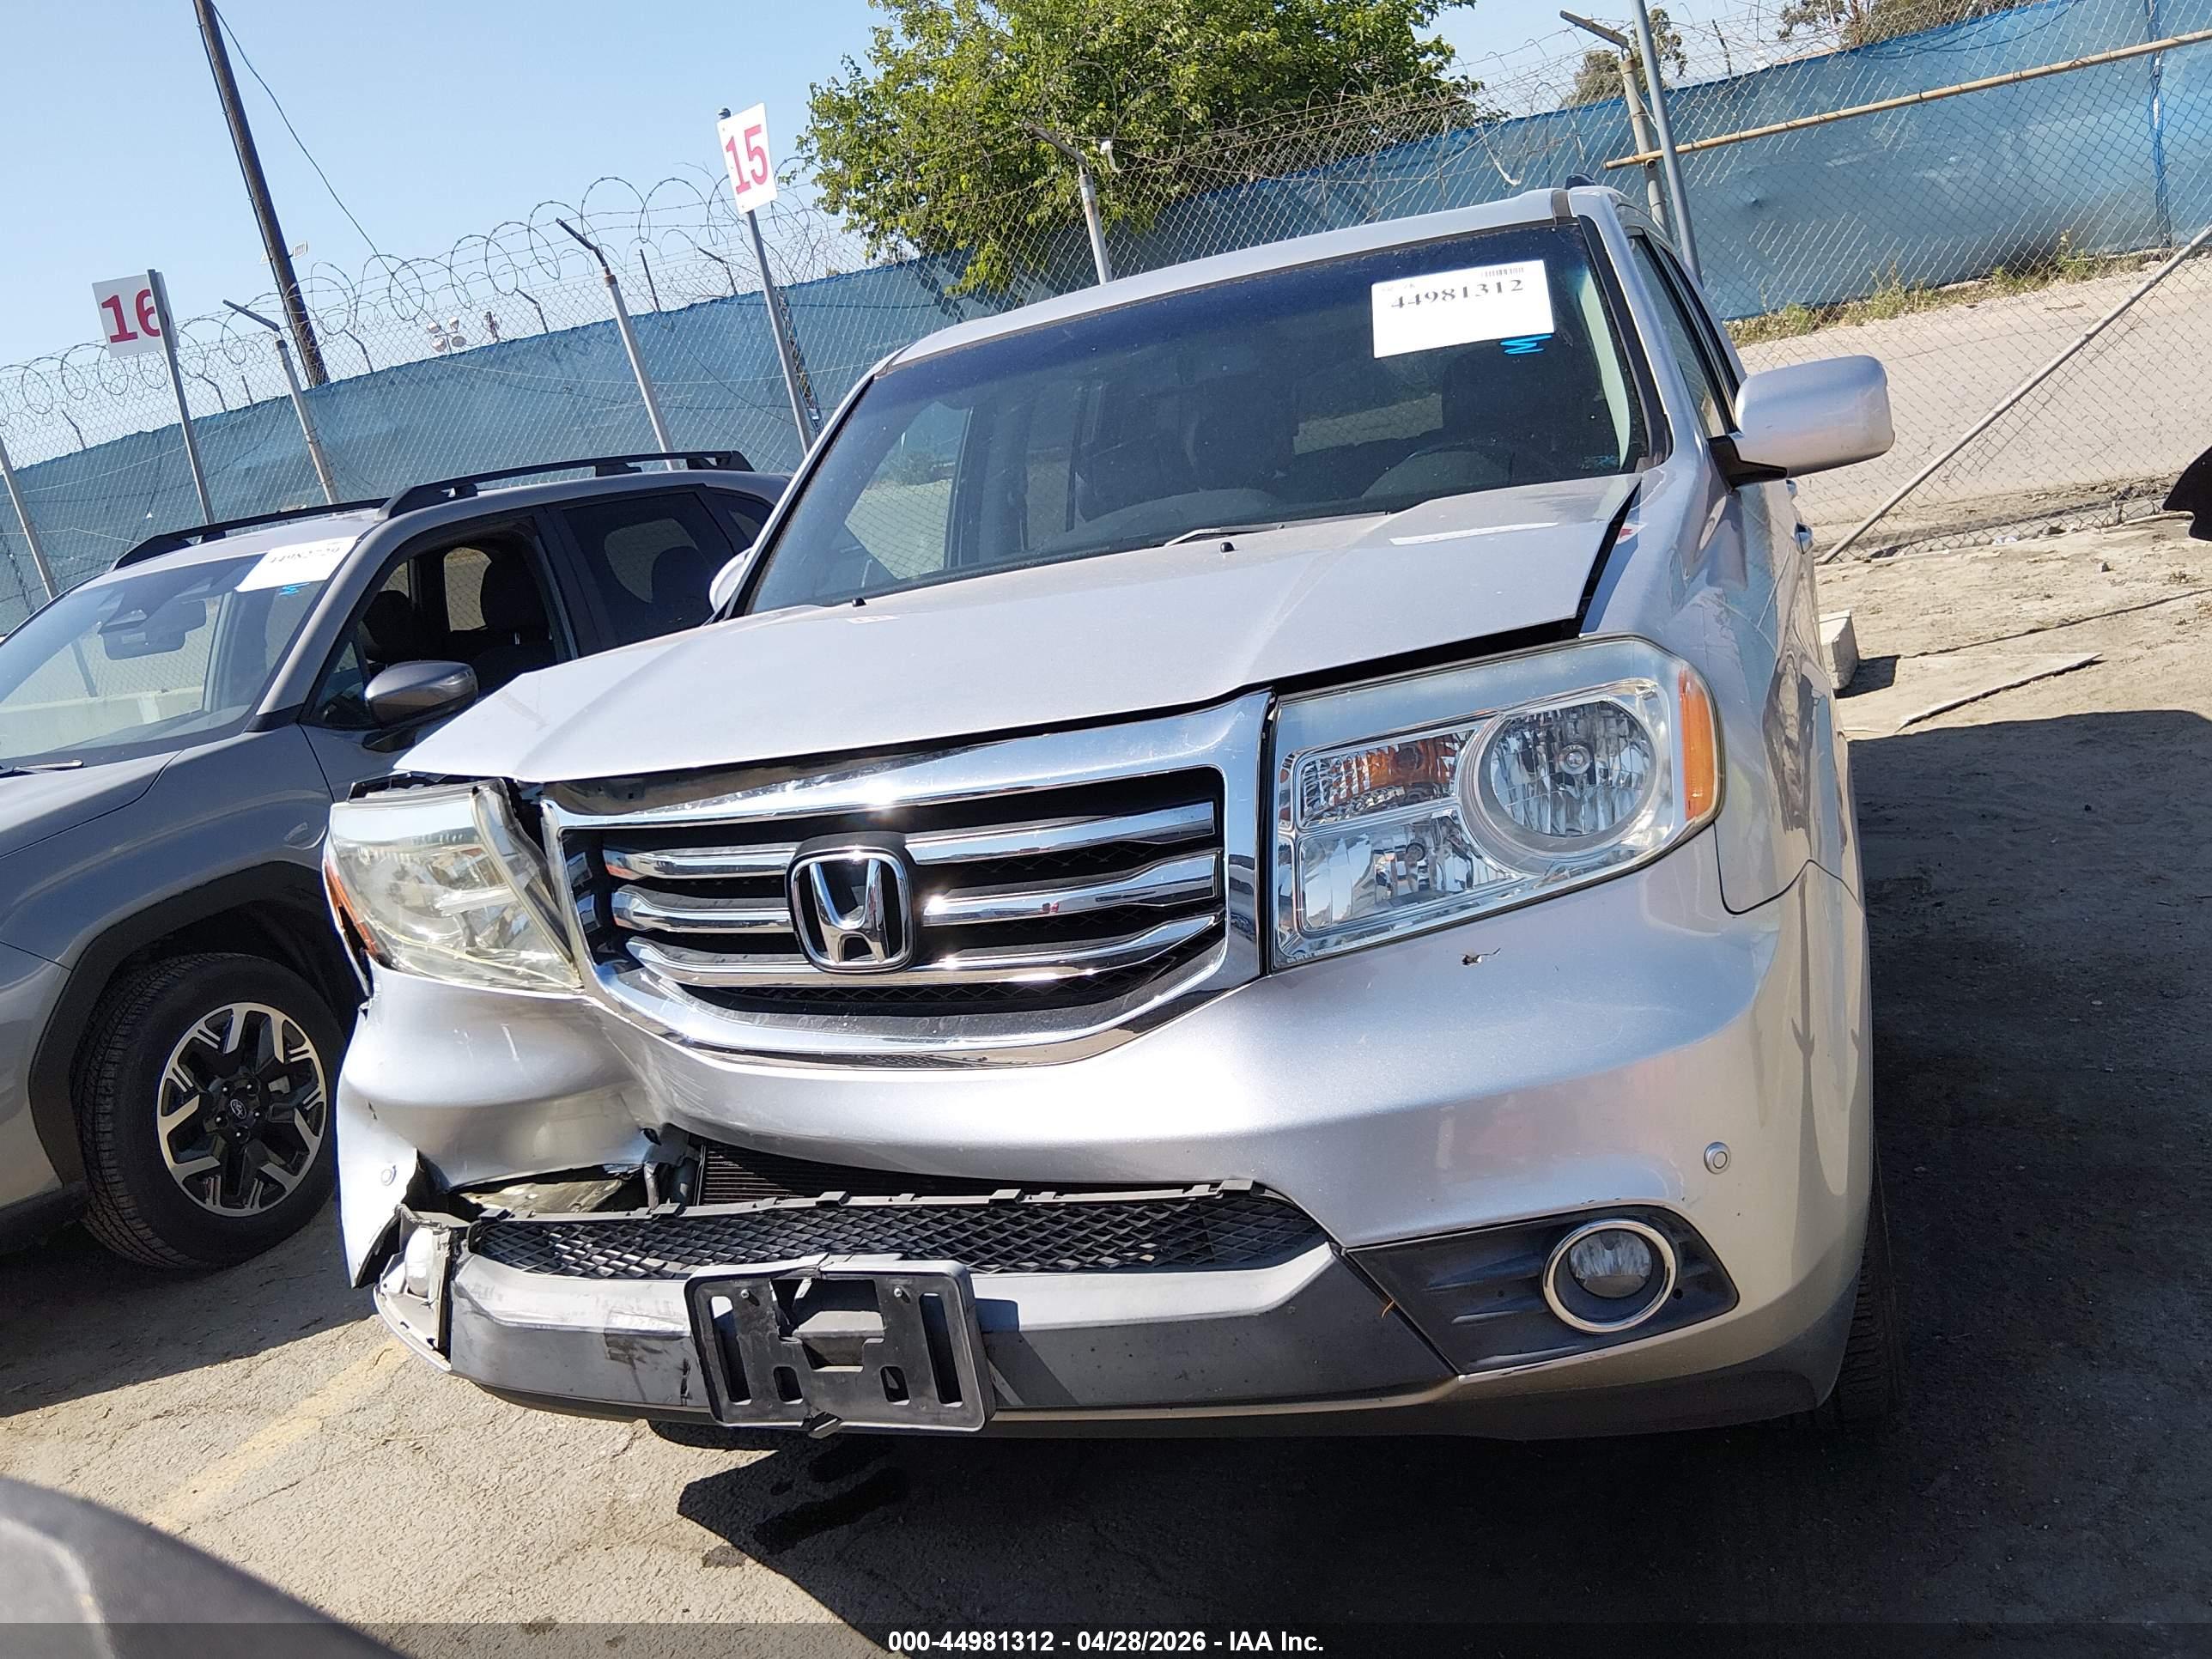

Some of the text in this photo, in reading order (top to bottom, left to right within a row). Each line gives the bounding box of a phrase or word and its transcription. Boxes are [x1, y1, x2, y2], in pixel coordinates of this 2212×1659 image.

[725, 124, 769, 196] 15
[100, 288, 161, 344] 16
[1390, 278, 1525, 310] 44981312
